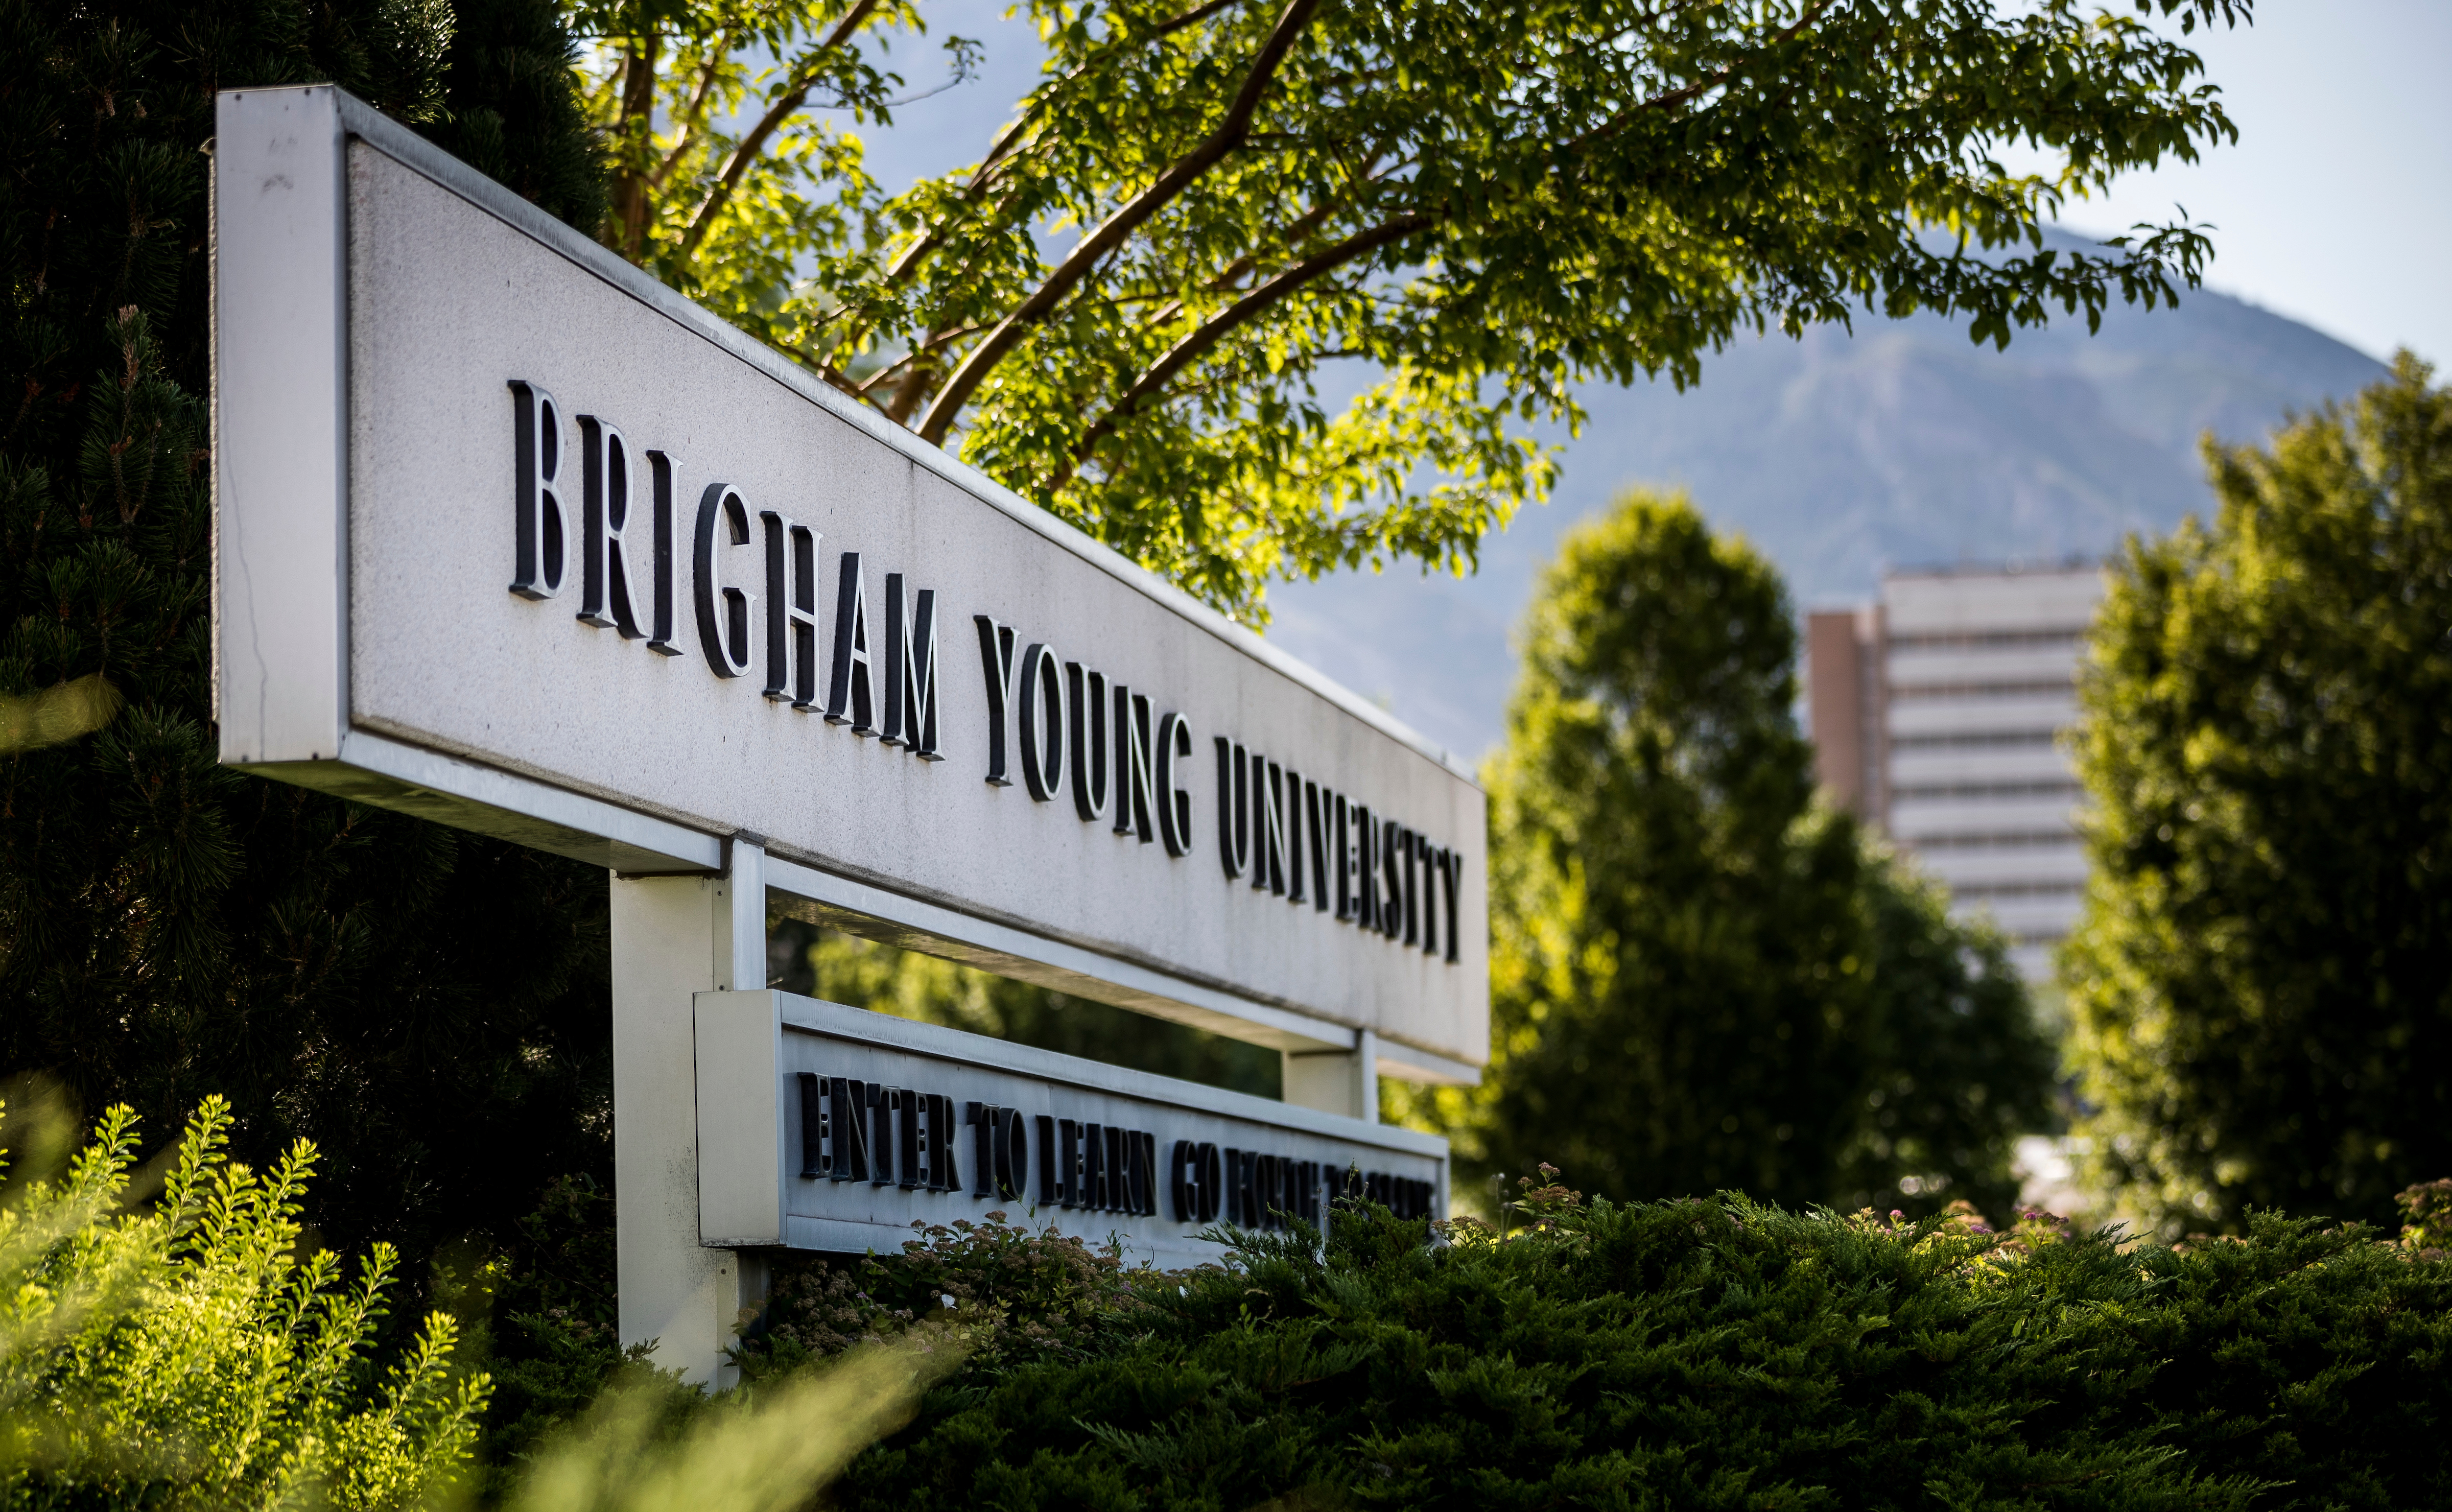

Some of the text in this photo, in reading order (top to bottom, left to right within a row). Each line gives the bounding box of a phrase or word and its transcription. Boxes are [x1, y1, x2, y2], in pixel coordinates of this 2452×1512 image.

[507, 380, 1463, 963] BRIGHAM YOUNG UNIVERSITY
[797, 1072, 962, 1193] ENTER
[966, 1101, 1027, 1202] TO
[1036, 1115, 1157, 1216] LEARN
[1171, 1140, 1221, 1223] GO
